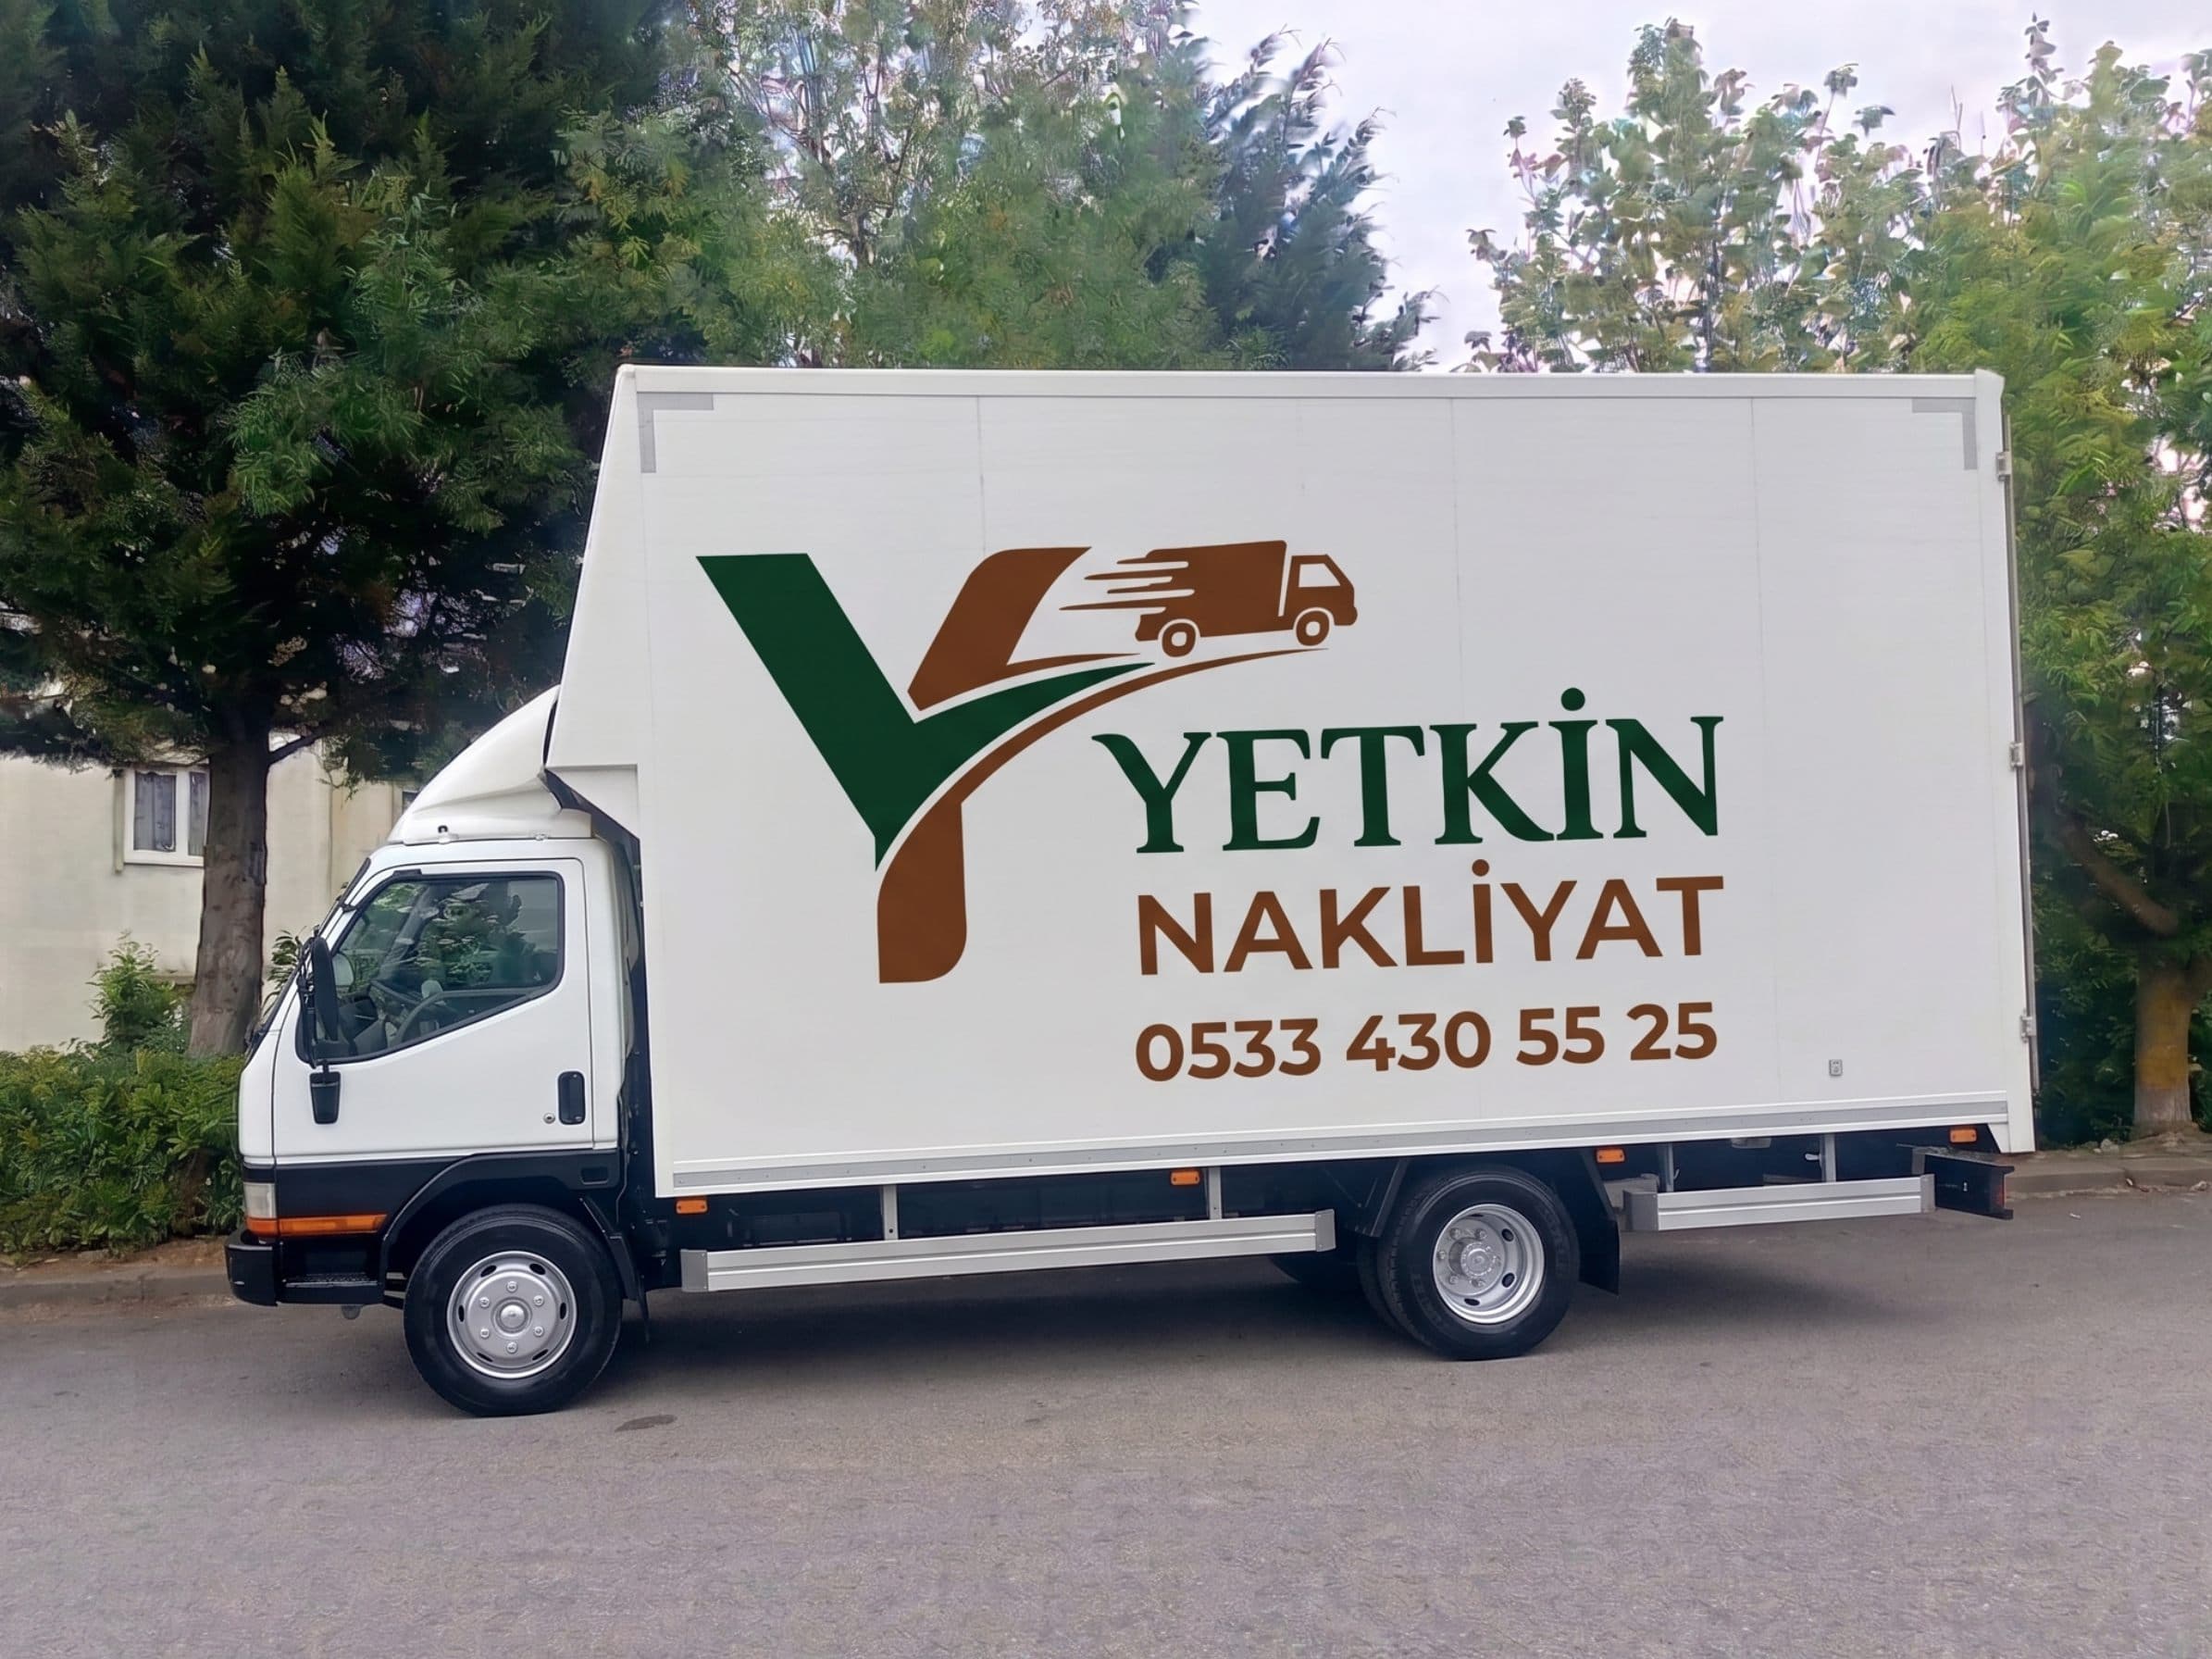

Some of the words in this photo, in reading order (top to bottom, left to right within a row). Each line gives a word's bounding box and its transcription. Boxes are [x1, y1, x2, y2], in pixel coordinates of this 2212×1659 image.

[1092, 687, 1724, 853] YETKİN
[1137, 859, 1724, 975] NAKLİYAT
[1136, 1017, 1321, 1082] 0533
[1346, 1011, 1491, 1071] 430
[1516, 1006, 1605, 1066] 55
[1627, 1002, 1717, 1061] 25
